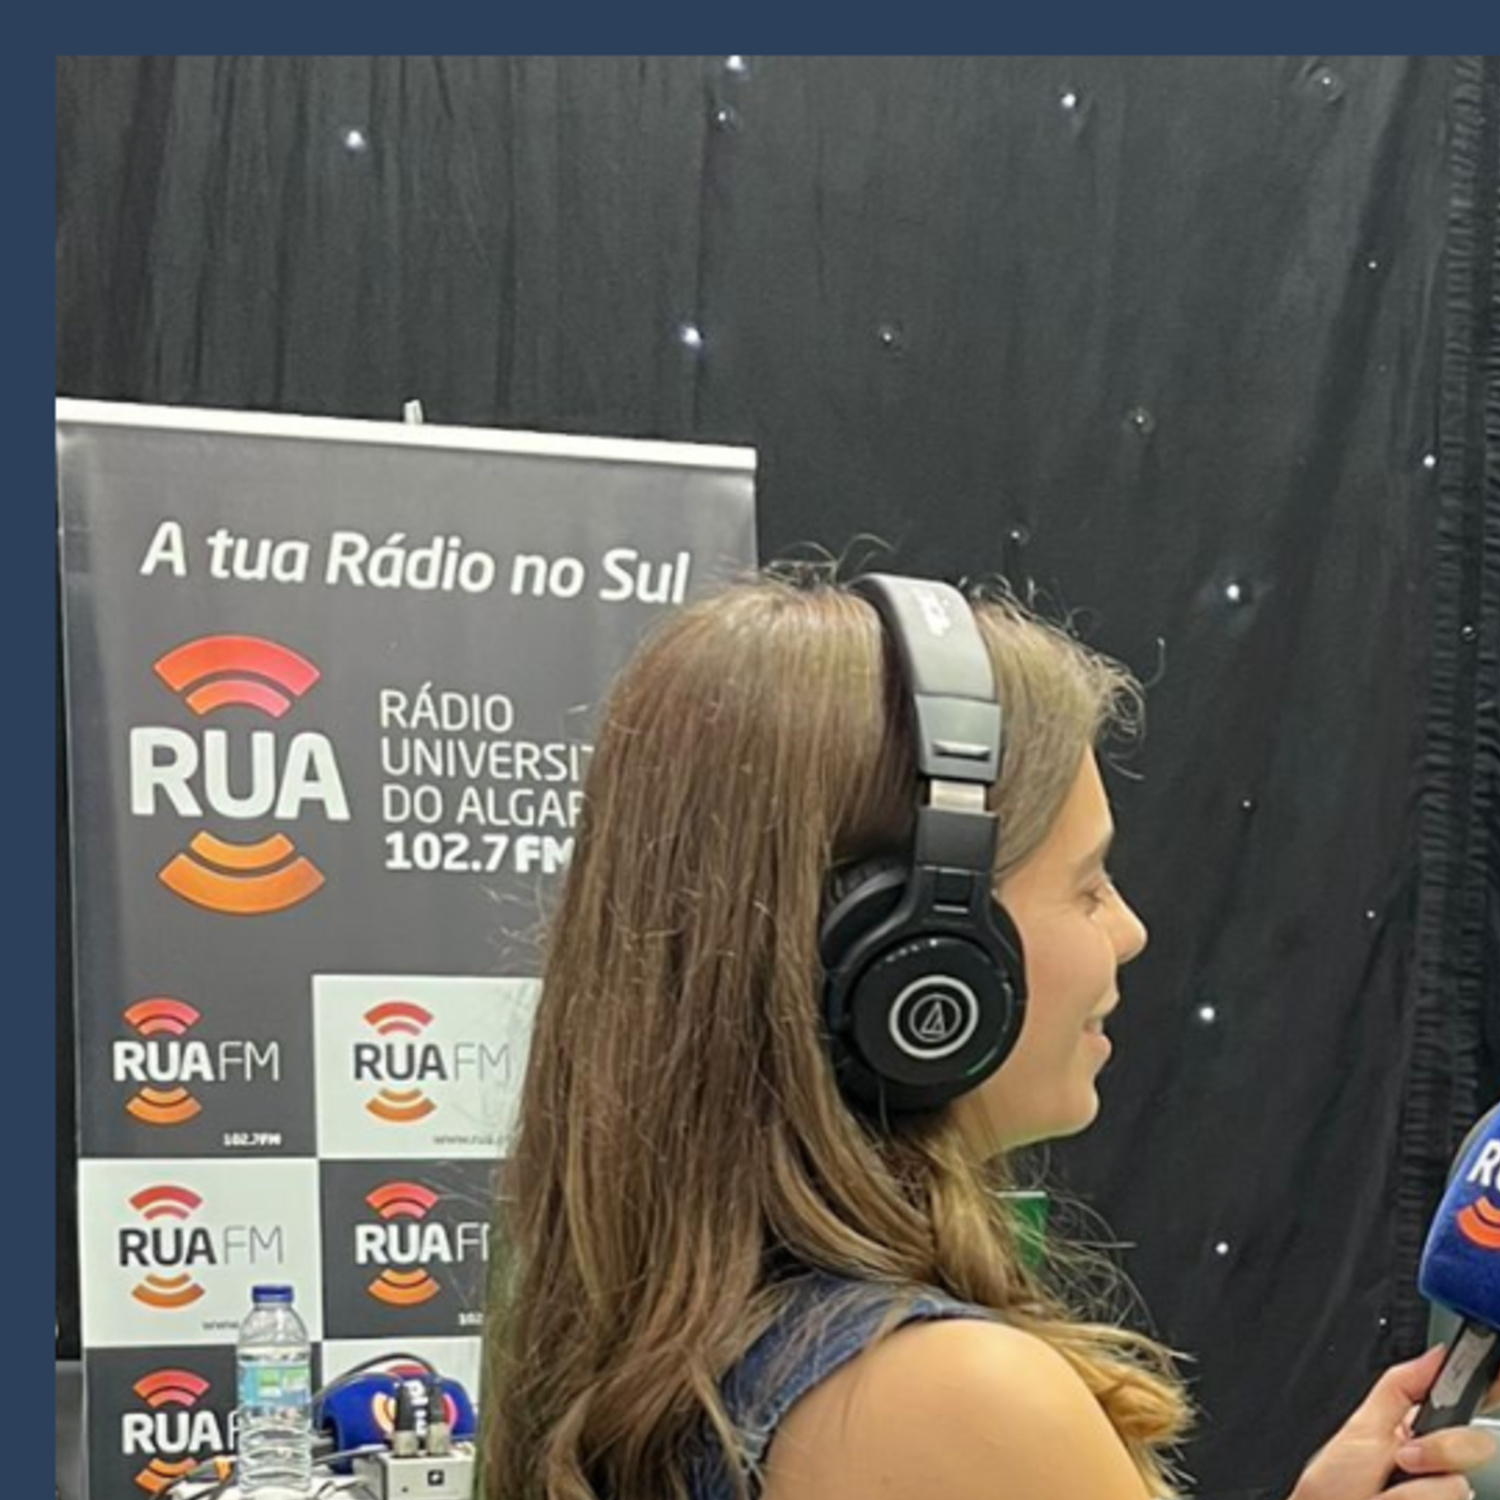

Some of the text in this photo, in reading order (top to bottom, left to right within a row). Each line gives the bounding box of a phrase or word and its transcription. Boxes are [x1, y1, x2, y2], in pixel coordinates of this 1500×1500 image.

[141, 521, 691, 605] A tua Rádio no Sul
[380, 681, 514, 733] RÁDIO
[130, 726, 351, 820] RUA
[382, 784, 443, 824] DO
